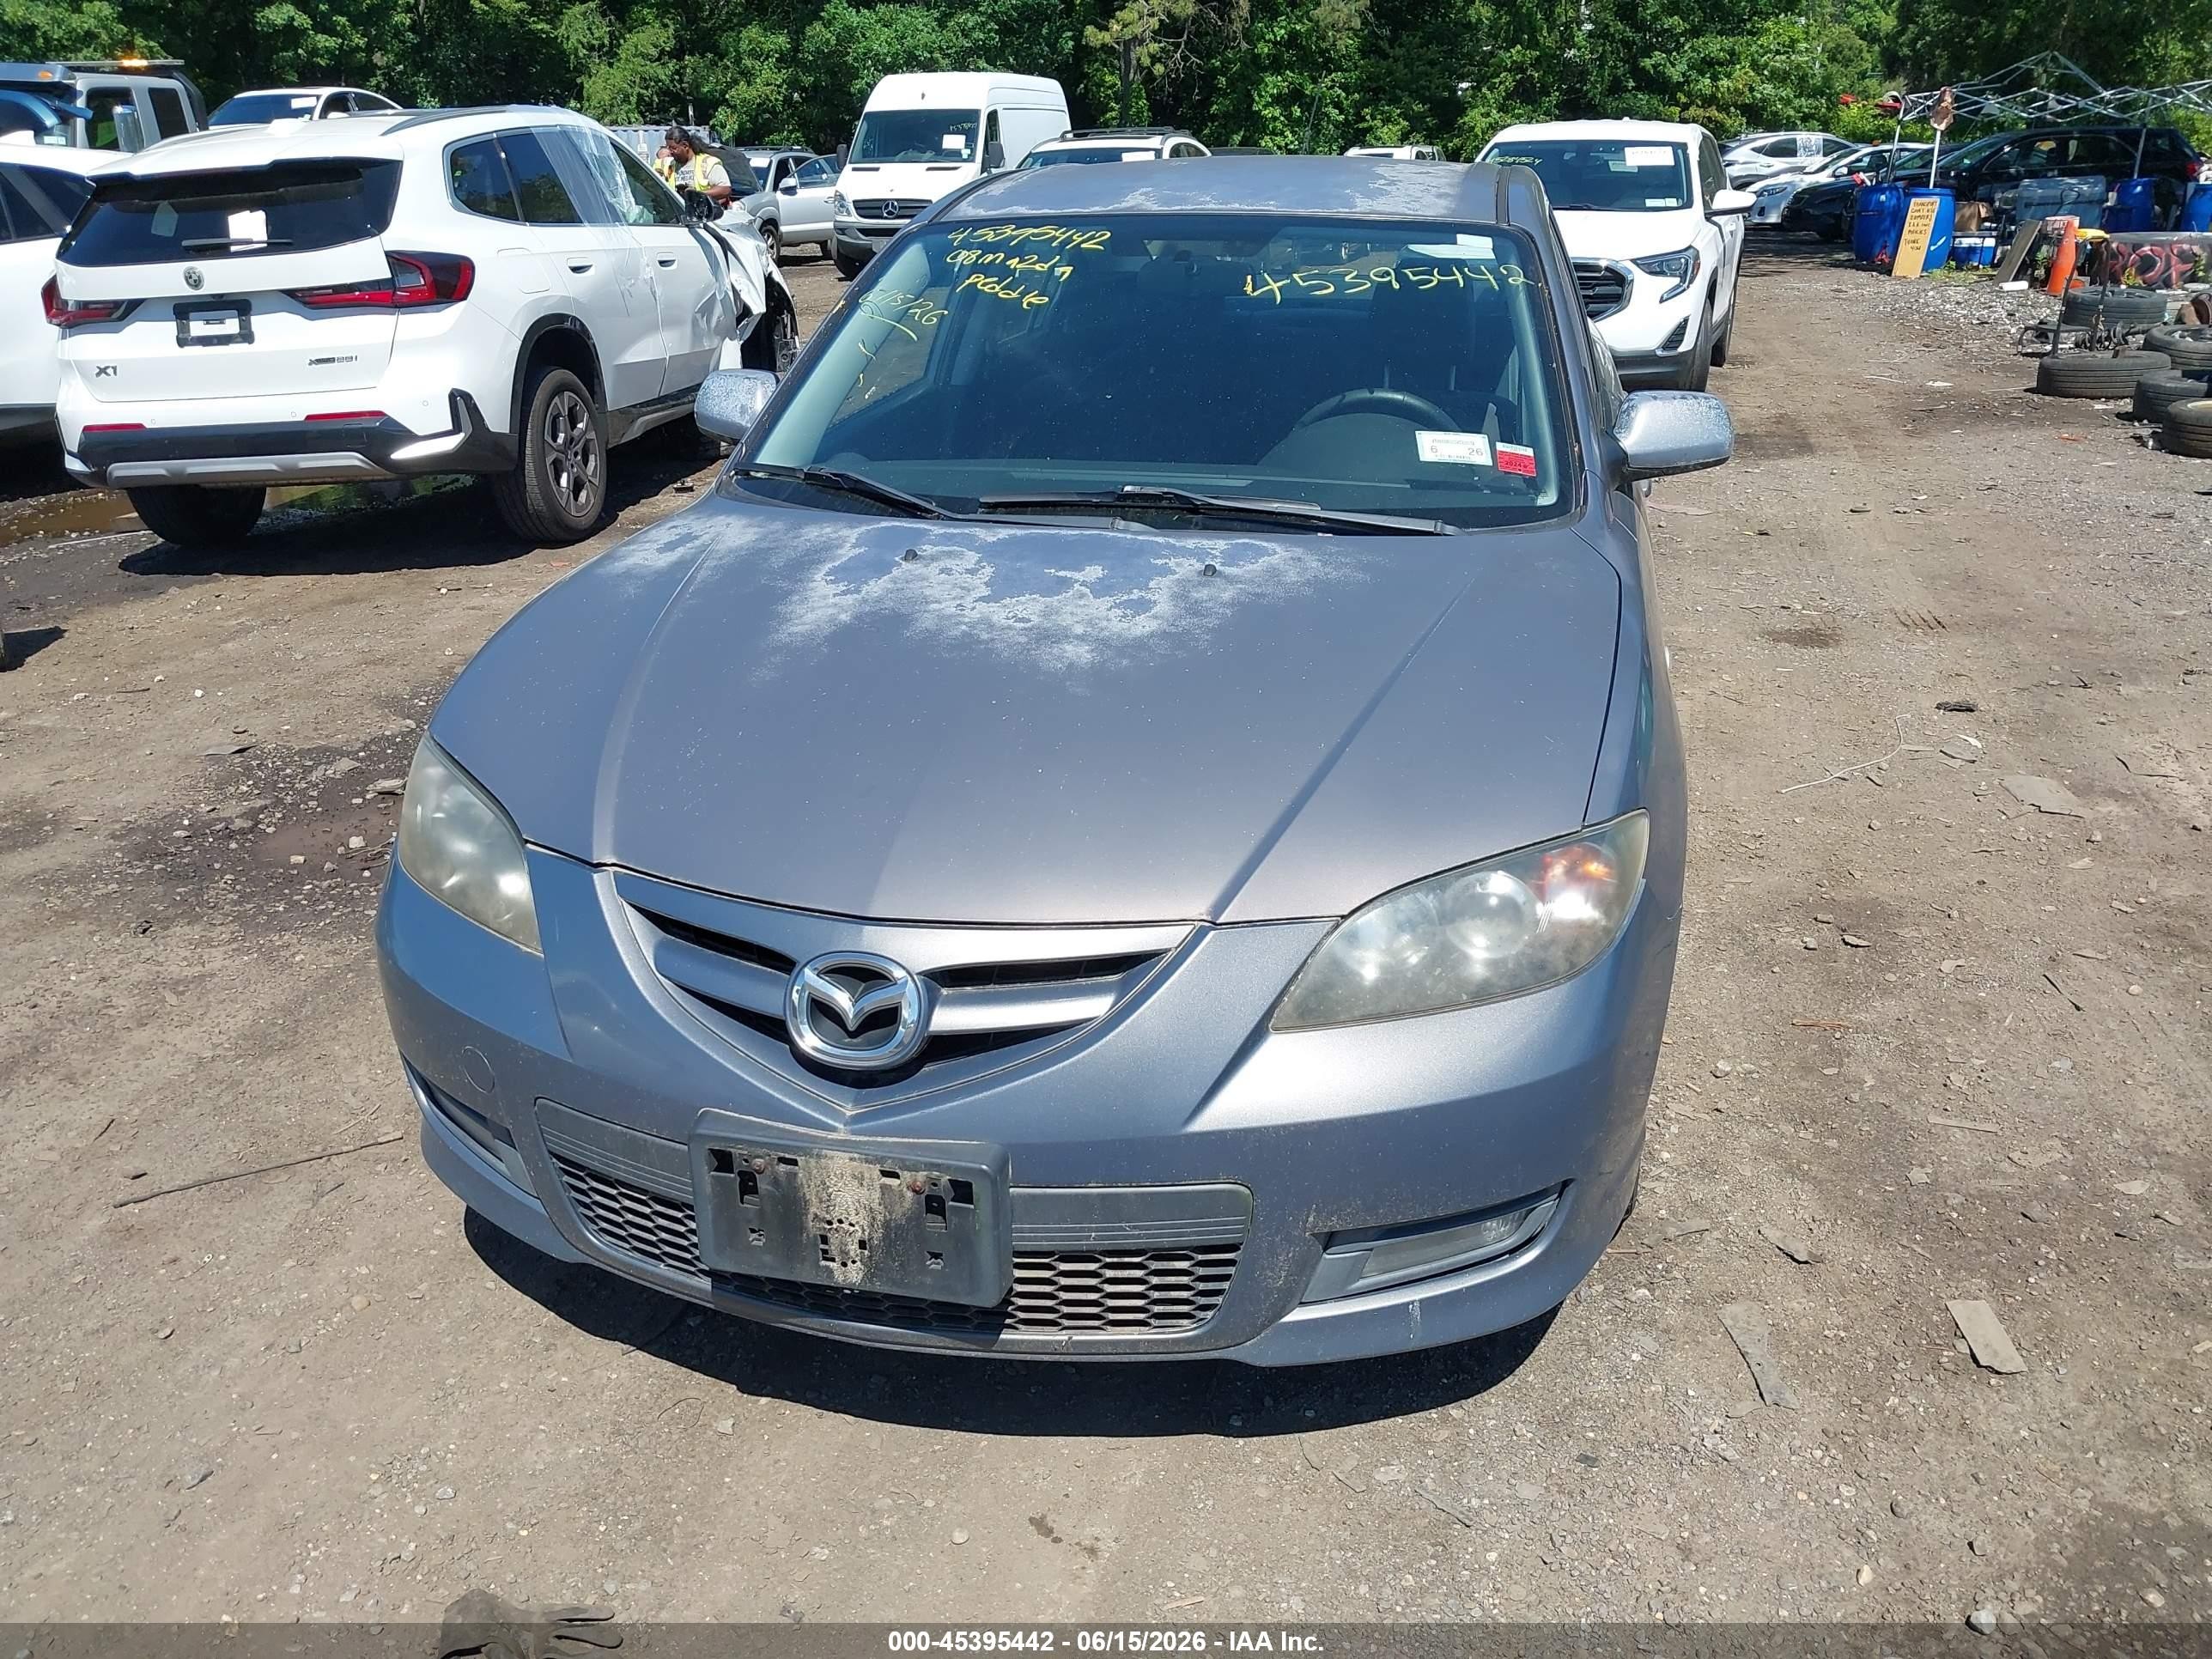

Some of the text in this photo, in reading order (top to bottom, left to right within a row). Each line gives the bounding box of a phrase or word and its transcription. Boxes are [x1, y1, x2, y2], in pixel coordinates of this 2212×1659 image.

[948, 224, 1111, 251] 45395442
[1243, 264, 1534, 304] 45395442
[94, 365, 118, 378] X1
[1430, 445, 1484, 457] 6 26
